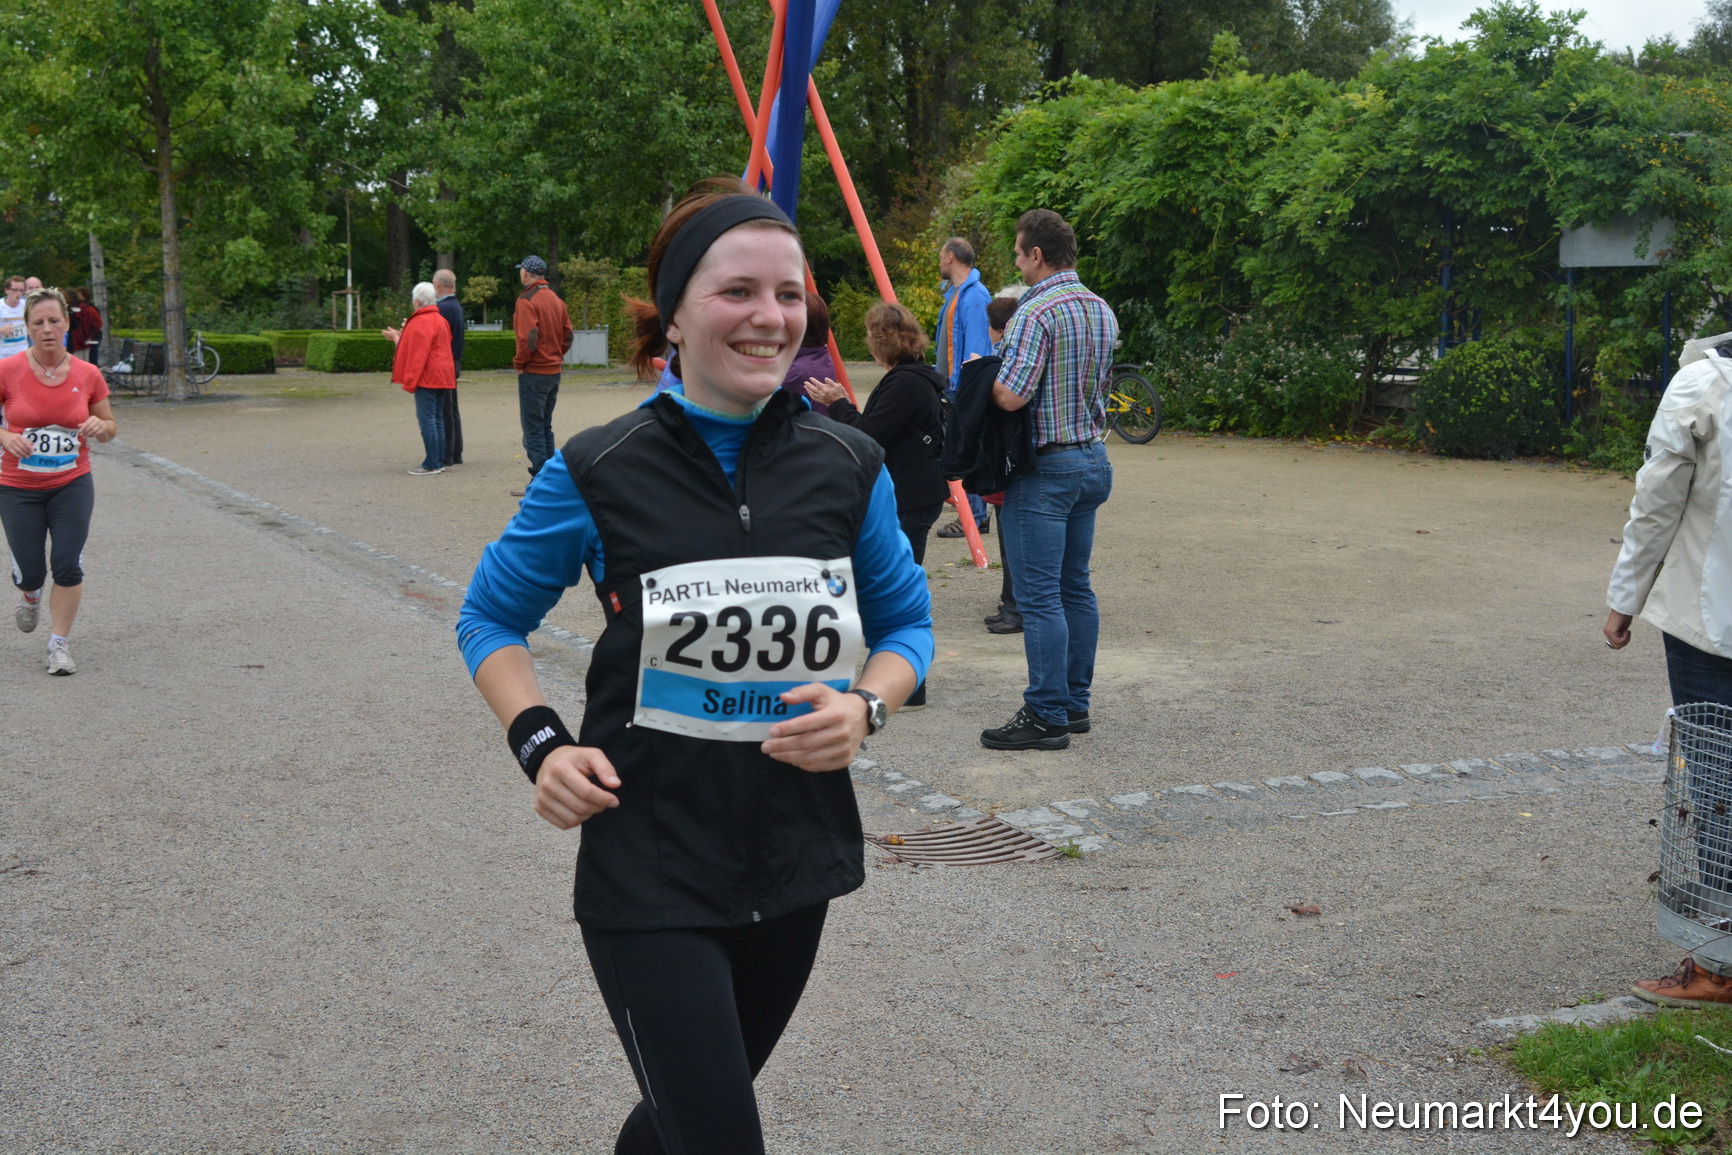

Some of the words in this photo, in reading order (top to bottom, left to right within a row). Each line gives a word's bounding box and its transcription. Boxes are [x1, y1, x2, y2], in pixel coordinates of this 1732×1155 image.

[27, 432, 75, 453] 2813
[649, 581, 719, 605] PARTL
[725, 577, 821, 596] Neumarkt
[665, 604, 842, 673] 2336
[650, 656, 658, 667] C
[703, 688, 788, 716] Selina
